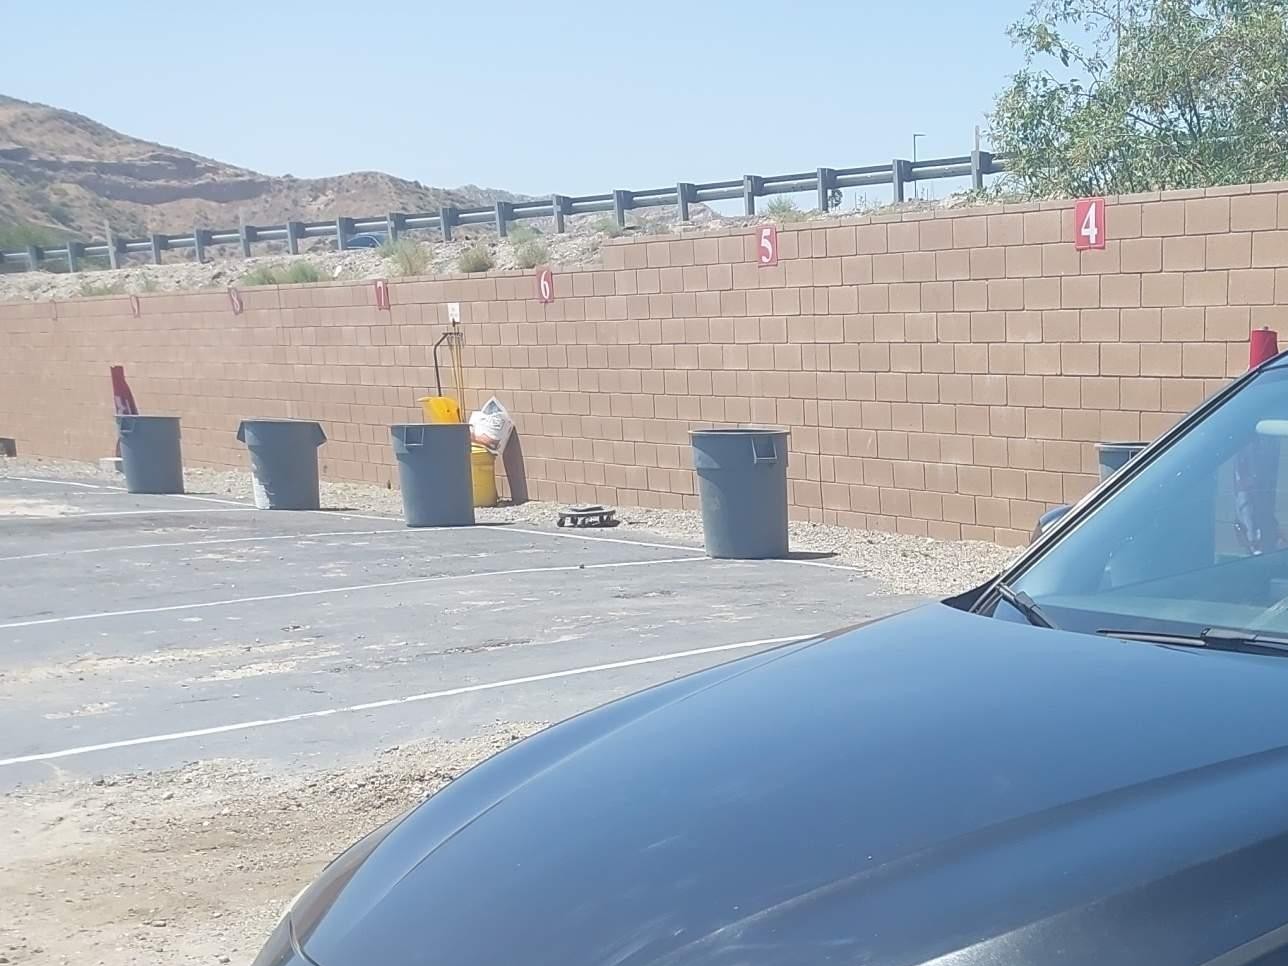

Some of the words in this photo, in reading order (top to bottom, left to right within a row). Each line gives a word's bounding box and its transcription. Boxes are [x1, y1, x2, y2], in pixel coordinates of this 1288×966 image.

[1080, 202, 1098, 244] 4
[759, 228, 774, 263] 5
[376, 280, 385, 307] 7
[540, 270, 550, 300] 6
[230, 289, 241, 312] 8
